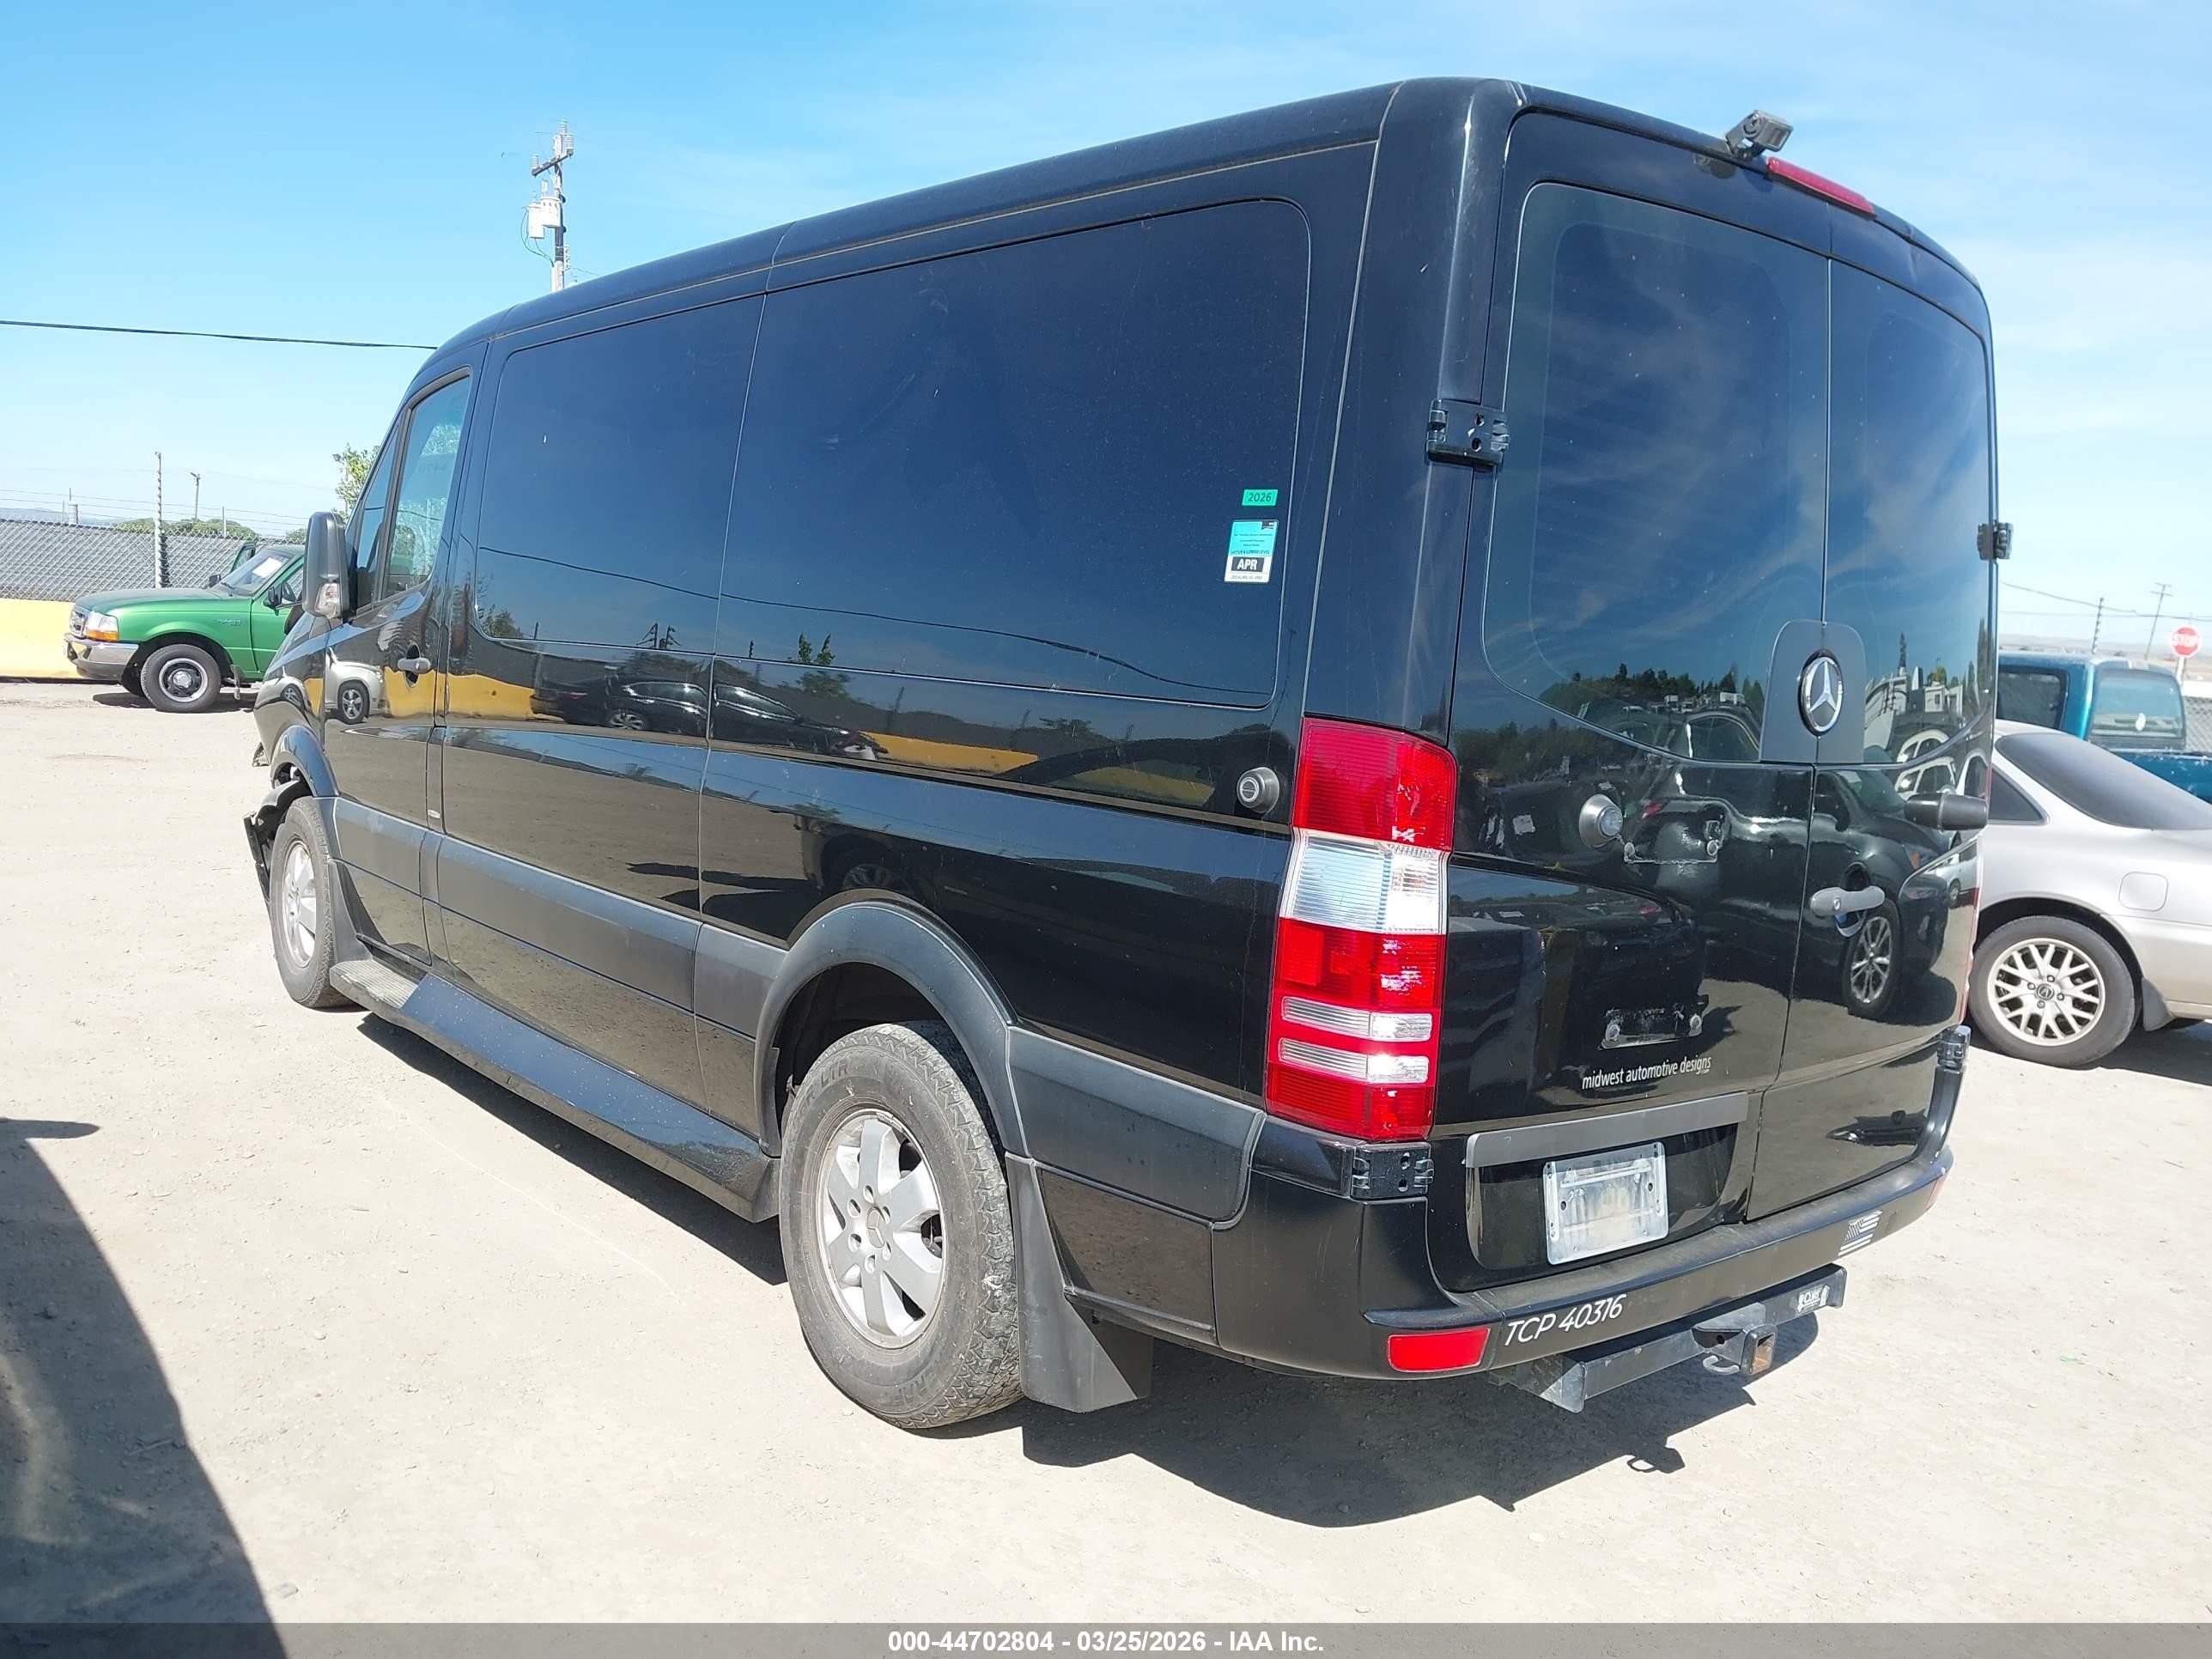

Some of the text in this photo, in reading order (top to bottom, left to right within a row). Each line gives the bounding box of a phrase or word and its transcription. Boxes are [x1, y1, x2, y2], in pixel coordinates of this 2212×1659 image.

[1248, 493, 1272, 502] 2026
[1237, 558, 1258, 570] APR
[2172, 634, 2198, 647] STOP
[1582, 1054, 1712, 1090] midwest automotive designs
[1504, 1293, 1627, 1346] TCP 40316
